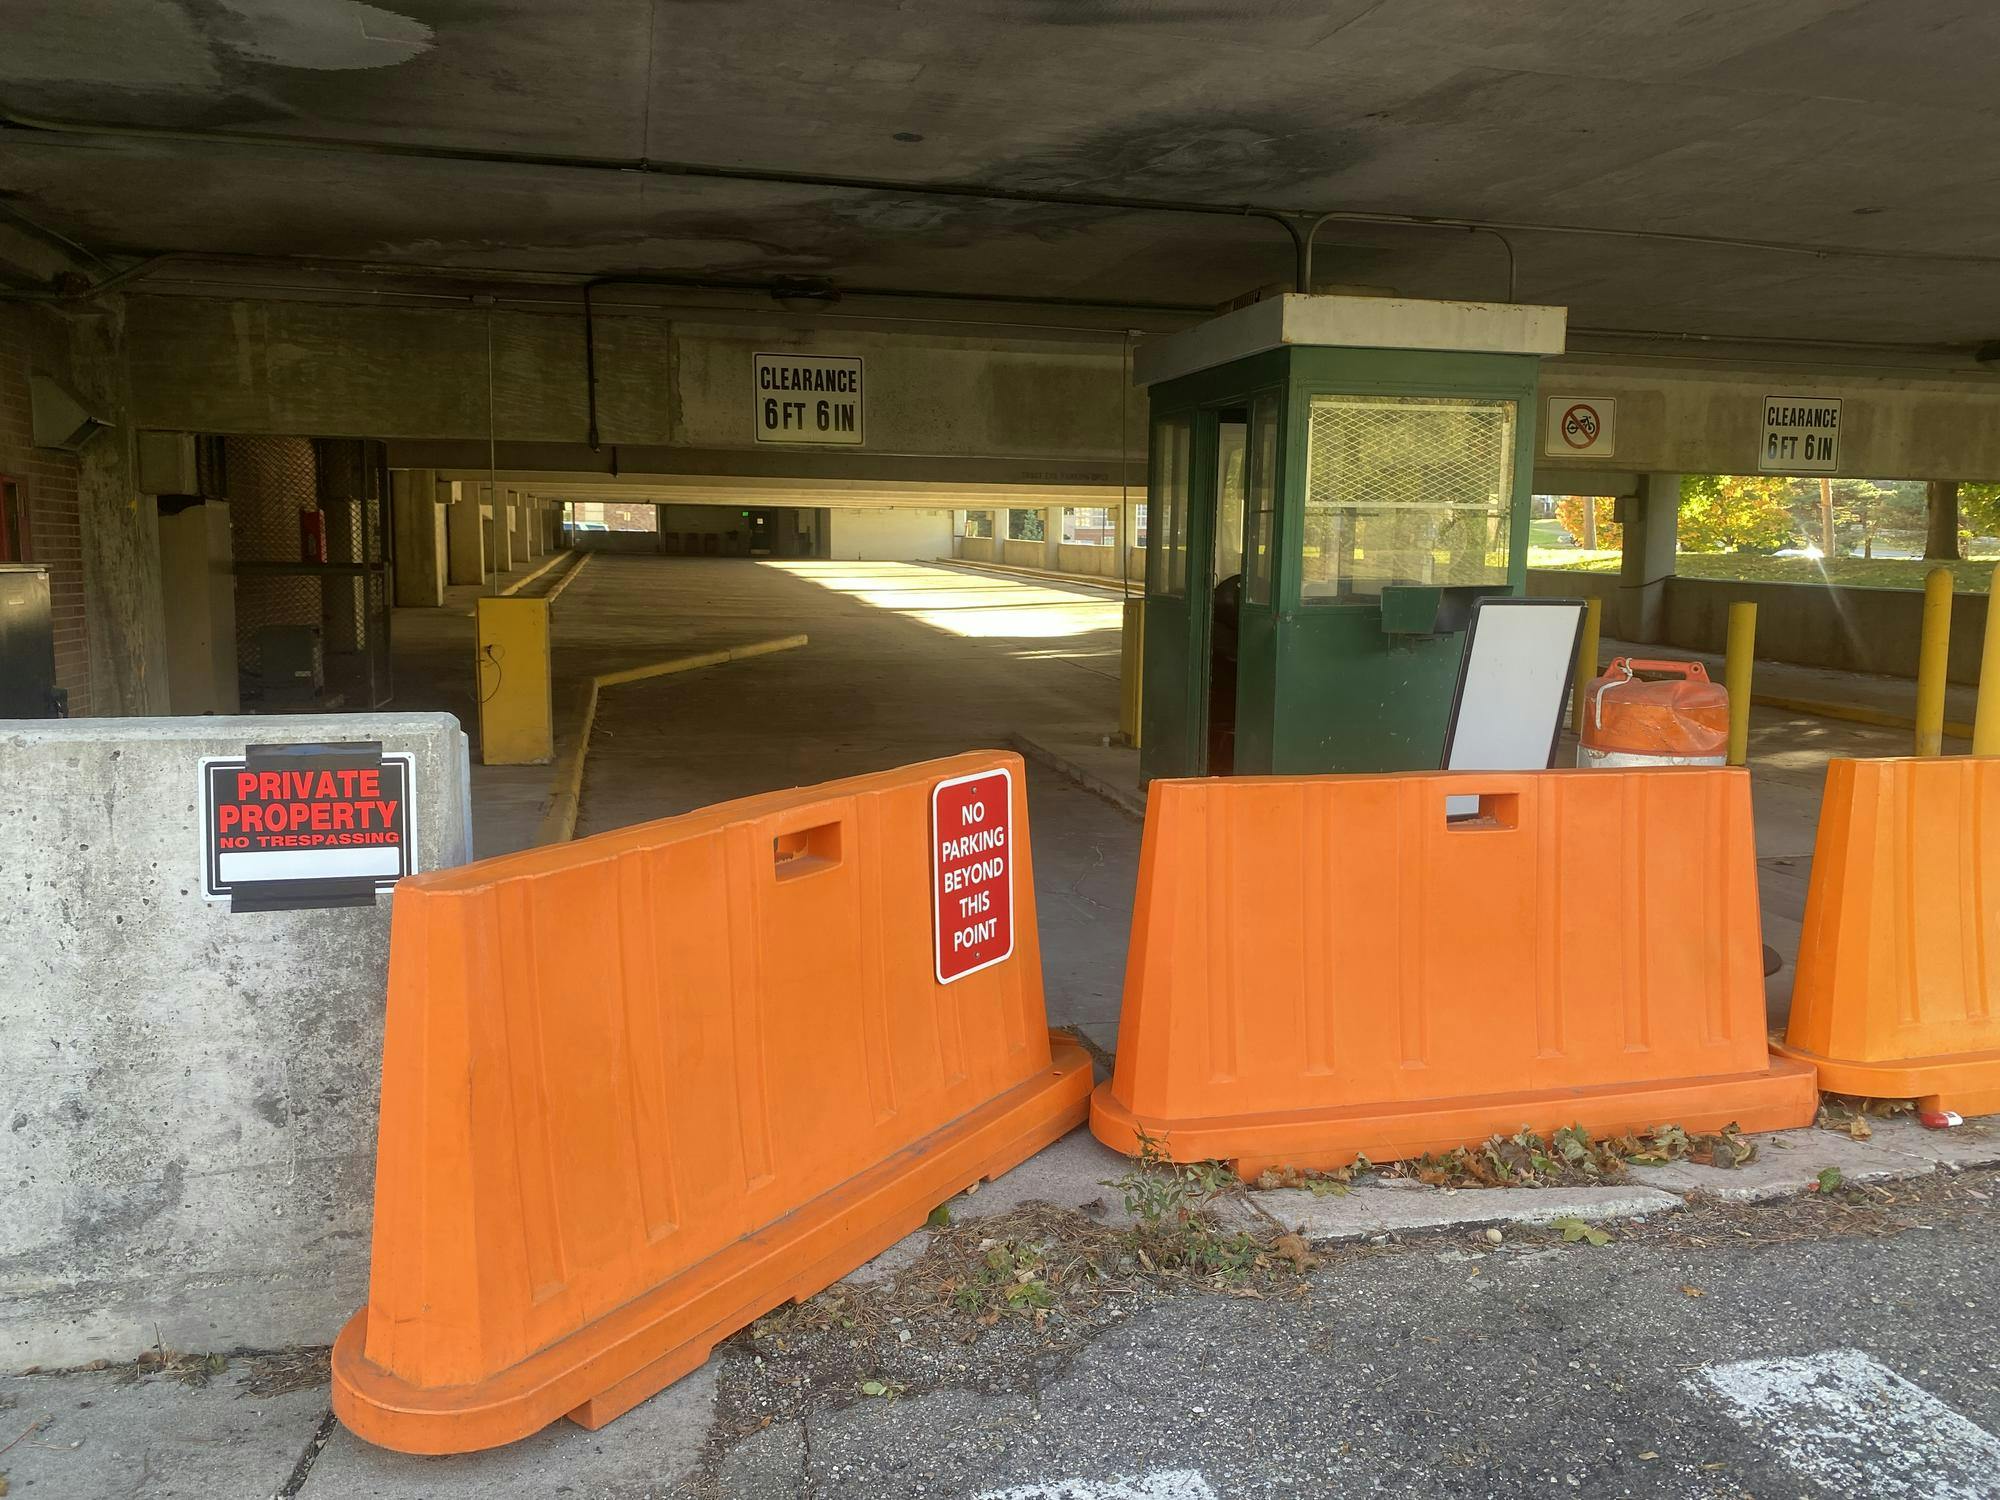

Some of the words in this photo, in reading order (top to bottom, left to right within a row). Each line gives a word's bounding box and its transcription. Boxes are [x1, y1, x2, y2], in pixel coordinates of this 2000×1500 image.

[760, 366, 857, 392] CLEARANCE
[1767, 406, 1837, 428] CLEARANCE
[237, 769, 380, 801] PRIVATE
[219, 800, 398, 833] PROPERTY
[961, 801, 985, 826] NO
[220, 836, 249, 849] NO
[257, 831, 399, 848] TRESPASSING
[942, 826, 1005, 863] PARKING
[944, 857, 1004, 894] BEYOND
[959, 890, 990, 918] THIS
[954, 917, 997, 952] POINT
